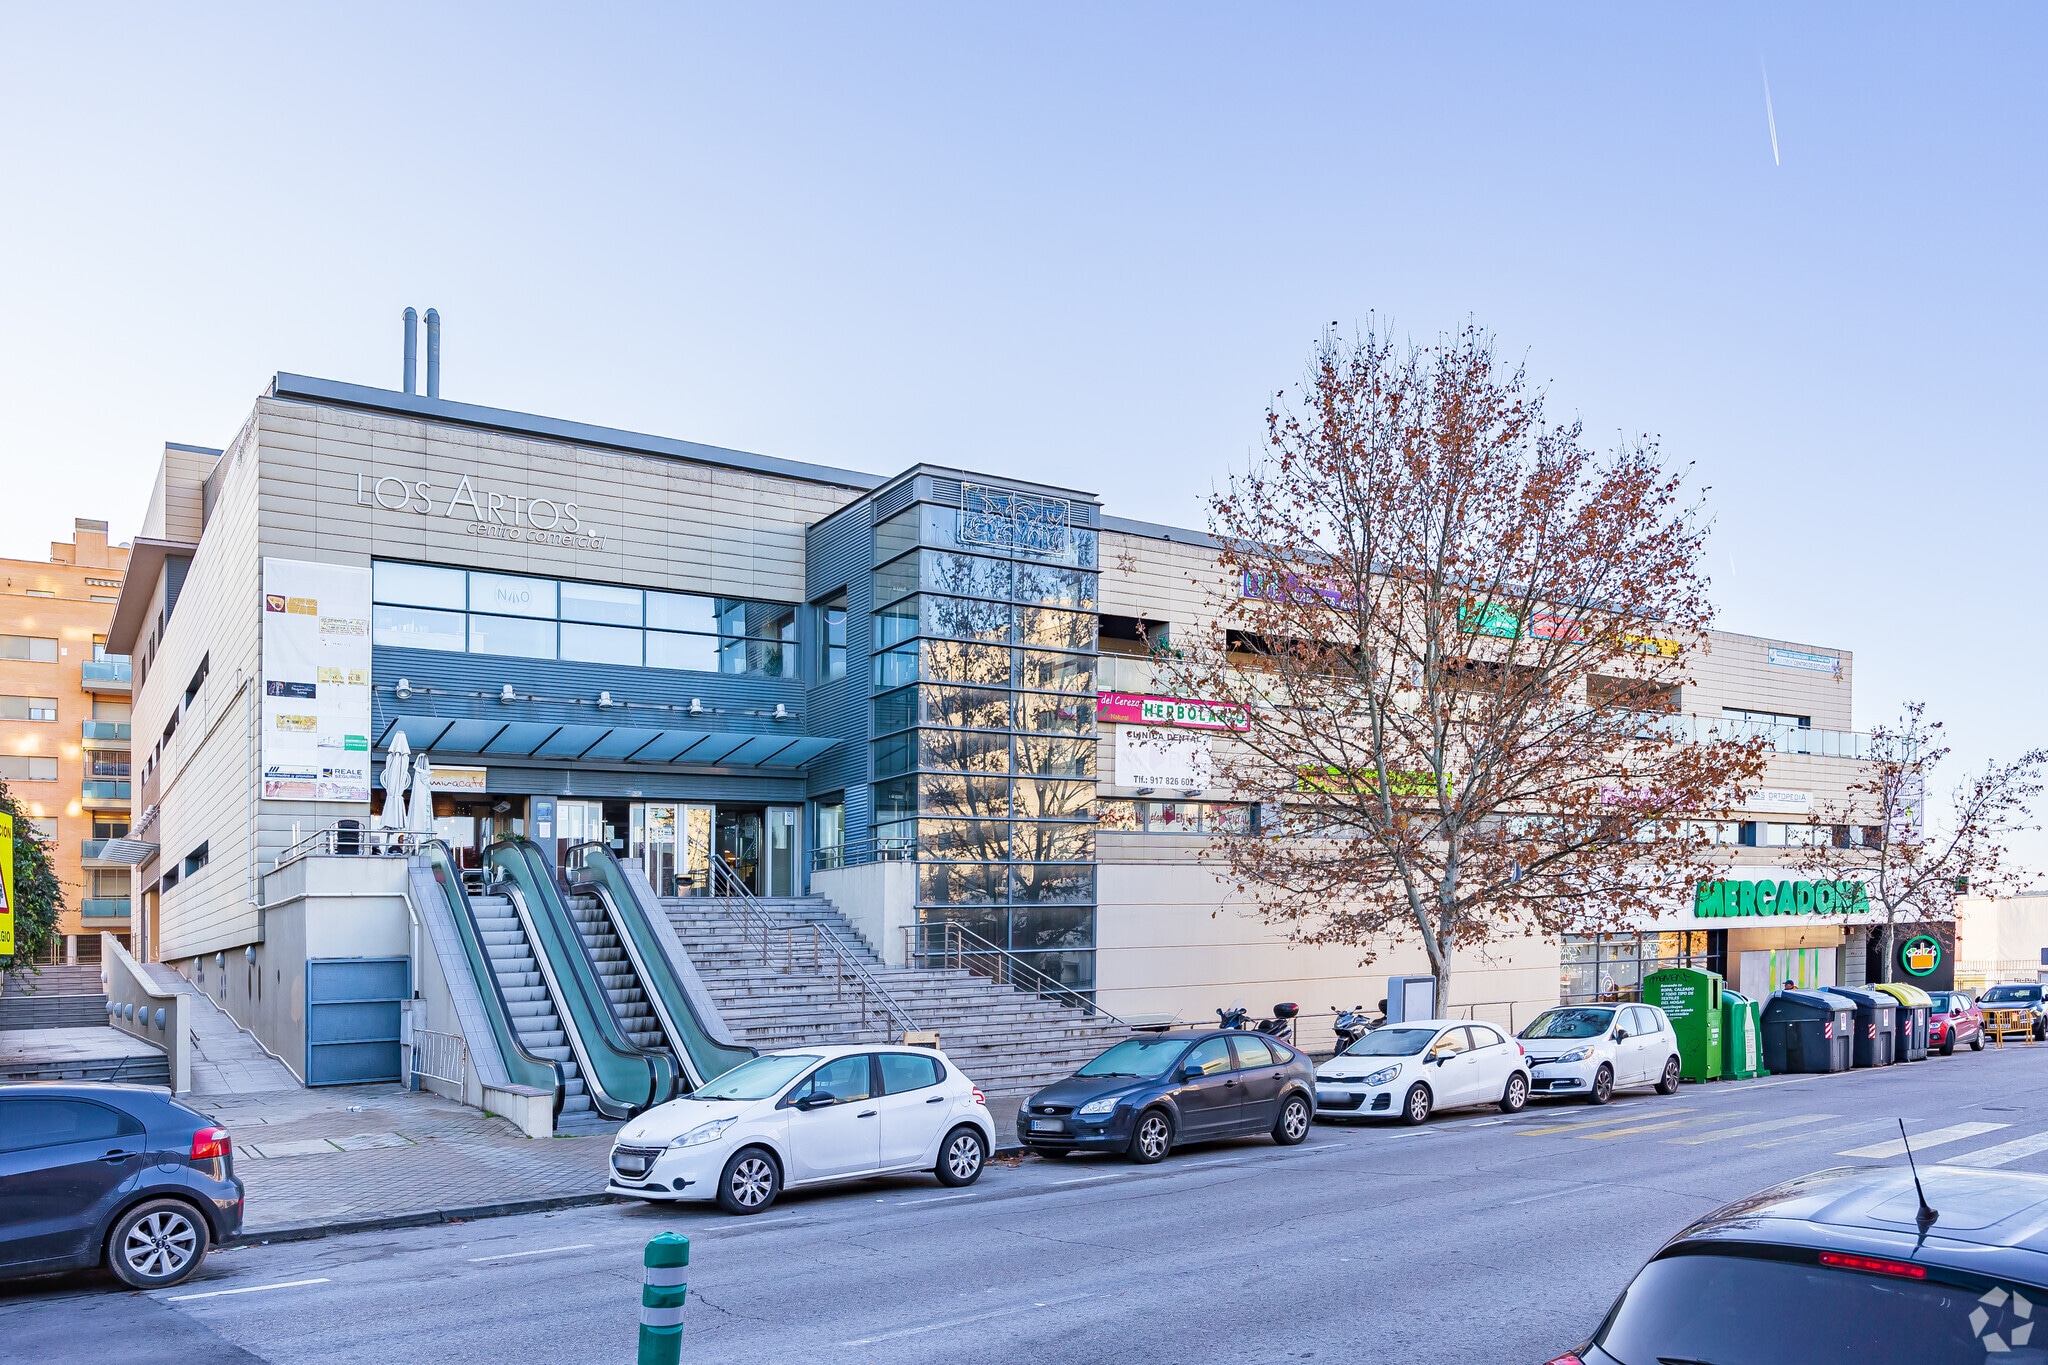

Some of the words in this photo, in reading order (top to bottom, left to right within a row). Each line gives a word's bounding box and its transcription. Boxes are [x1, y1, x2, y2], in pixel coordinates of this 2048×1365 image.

[356, 472, 432, 515] LOS
[466, 521, 521, 541] centro
[525, 528, 608, 551] comercial
[1101, 694, 1113, 705] del
[1114, 696, 1140, 707] Cerezo
[1144, 703, 1246, 724] HERBOLAIO
[1166, 733, 1202, 743] DENTAL
[429, 776, 485, 788] miracafé
[1149, 776, 1163, 785] 917
[1165, 777, 1179, 786] 826
[1768, 792, 1807, 801] ORTOPEDIA
[1694, 879, 1870, 918] MERCADONA
[0, 930, 11, 943] GIO
